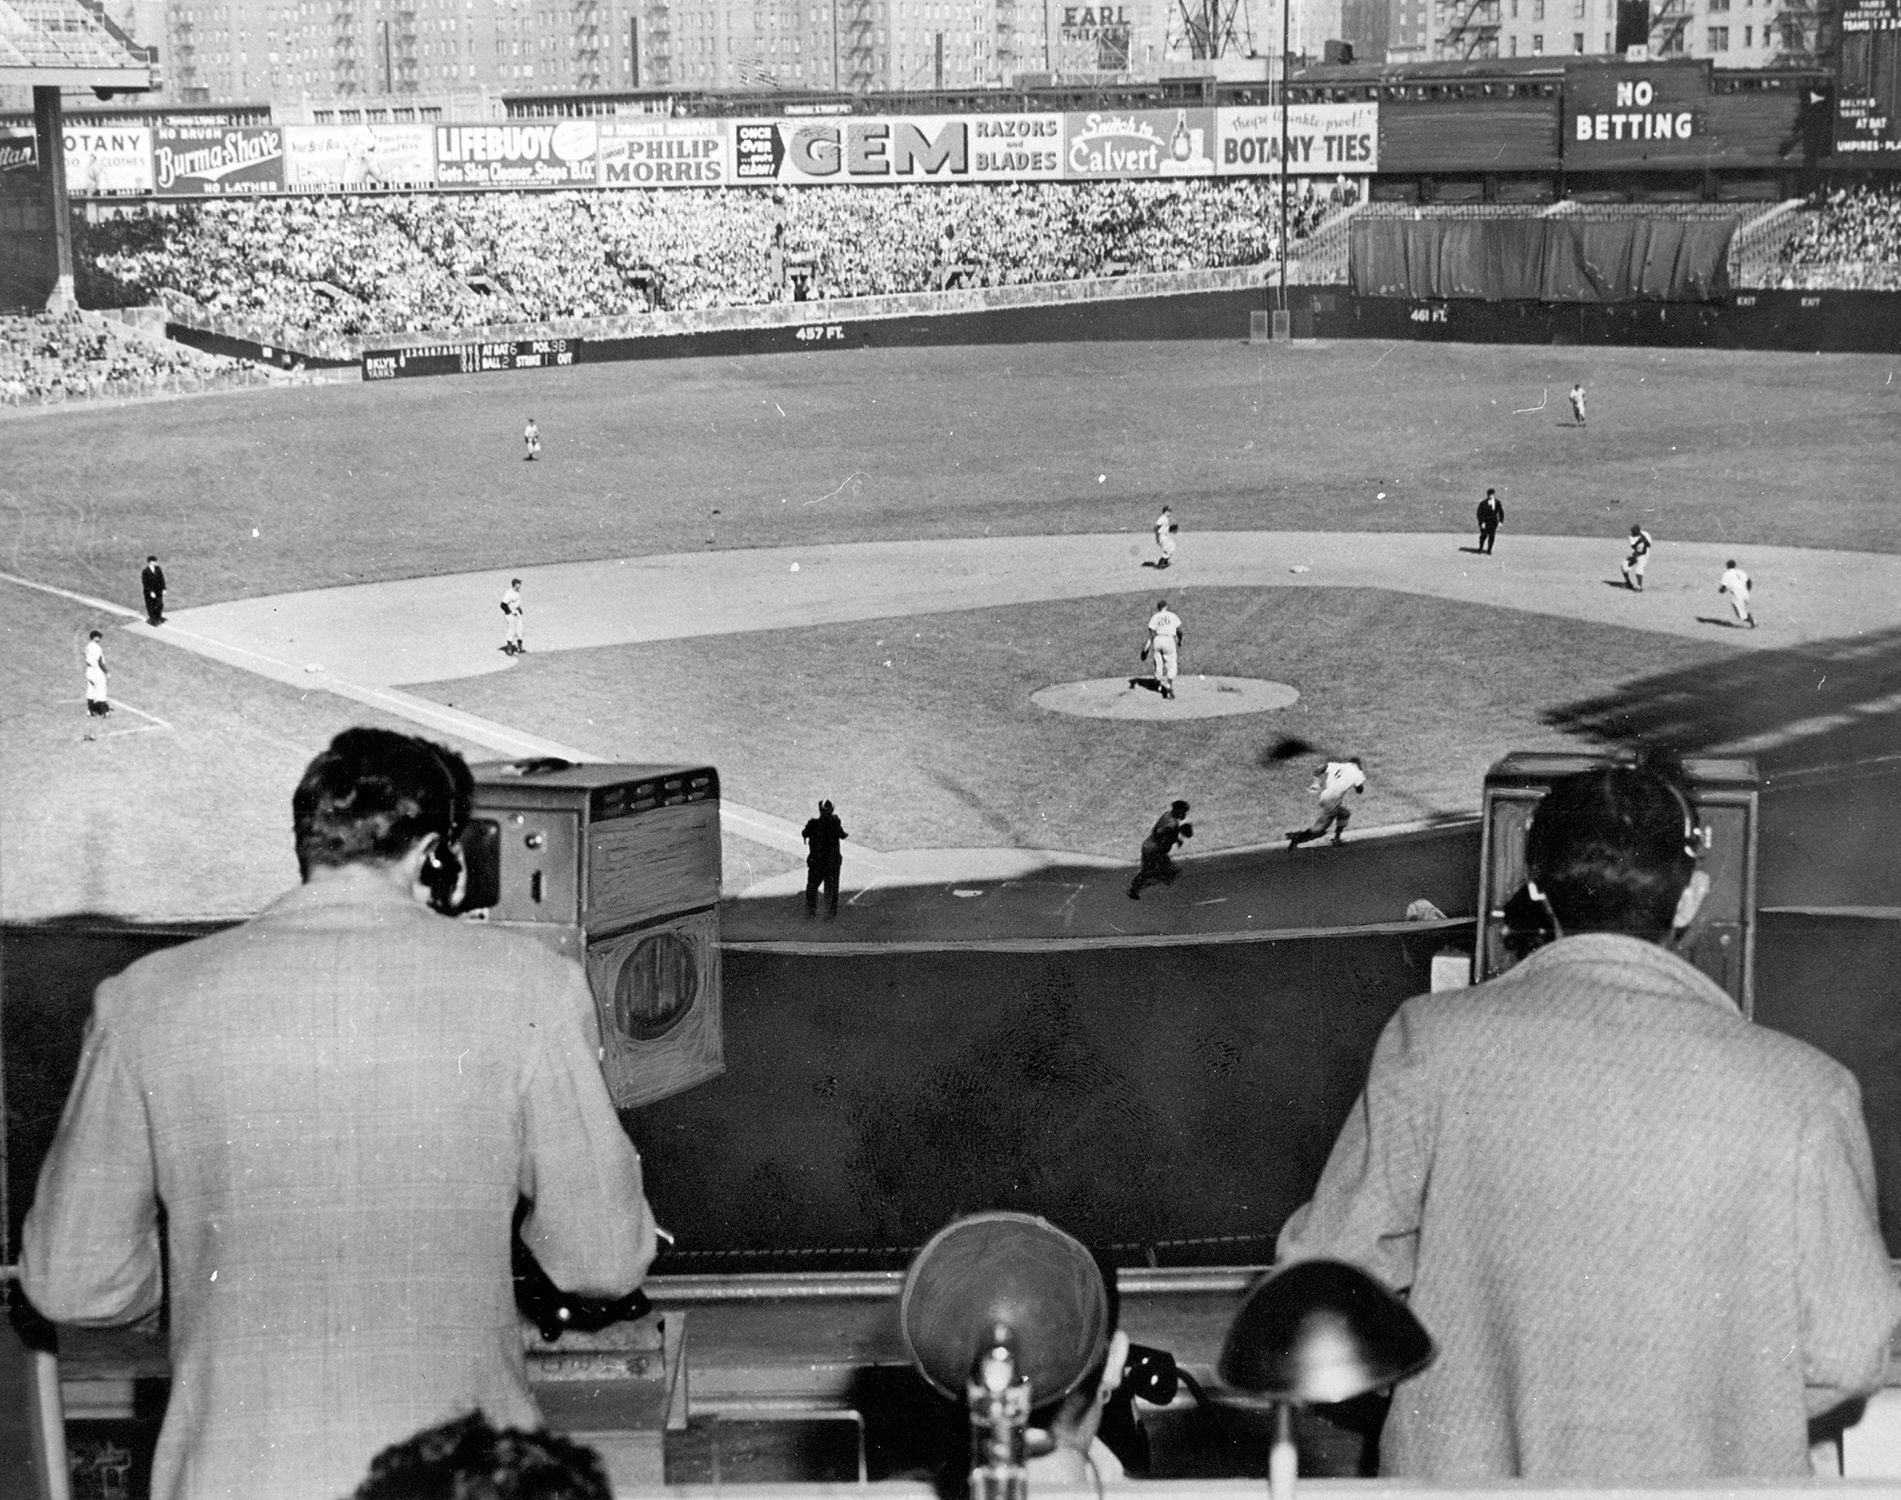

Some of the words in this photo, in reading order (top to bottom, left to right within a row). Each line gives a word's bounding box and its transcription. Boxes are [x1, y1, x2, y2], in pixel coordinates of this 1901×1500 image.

[1061, 6, 1131, 27] EARL
[1843, 10, 1891, 19] AMERICAN
[1842, 20, 1870, 31] TEAMS
[1616, 81, 1653, 107] NO
[975, 120, 1057, 138] RAZORS
[1081, 112, 1136, 135] Switch
[1576, 113, 1693, 140] BETTING
[1855, 117, 1868, 129] AT
[1868, 117, 1887, 129] BAT
[159, 129, 176, 139] NO
[740, 127, 772, 139] ONCE
[64, 135, 140, 151] OTANY
[437, 126, 554, 161] LIFEBUOY
[627, 139, 720, 160] PHILIP
[740, 140, 772, 153] OVER
[789, 121, 968, 176] GEM
[1006, 141, 1024, 149] and
[1224, 134, 1315, 164] BOTANY
[1323, 133, 1371, 162] TIES
[1837, 140, 1879, 152] UMPIRES
[100, 157, 146, 168] CLOTHES
[154, 130, 282, 188] Burma-Shave
[975, 151, 1057, 171] BLADES
[1069, 141, 1158, 172] Calvert
[438, 163, 463, 182] Gets
[464, 162, 489, 181] Skin
[605, 161, 722, 182] MORRIS
[203, 182, 221, 193] NO
[225, 181, 278, 193] LATHER
[1410, 309, 1429, 323] 461
[796, 326, 824, 341] 457
[826, 325, 845, 340] FT.
[482, 344, 493, 356] AT
[493, 343, 509, 356] BAT
[509, 342, 518, 356] 6
[482, 356, 501, 369] BALL
[502, 356, 510, 369] 2
[515, 354, 542, 367] STRIKE
[557, 352, 573, 365] OUT
[368, 368, 396, 379] YANKS
[1157, 616, 1171, 627] 26
